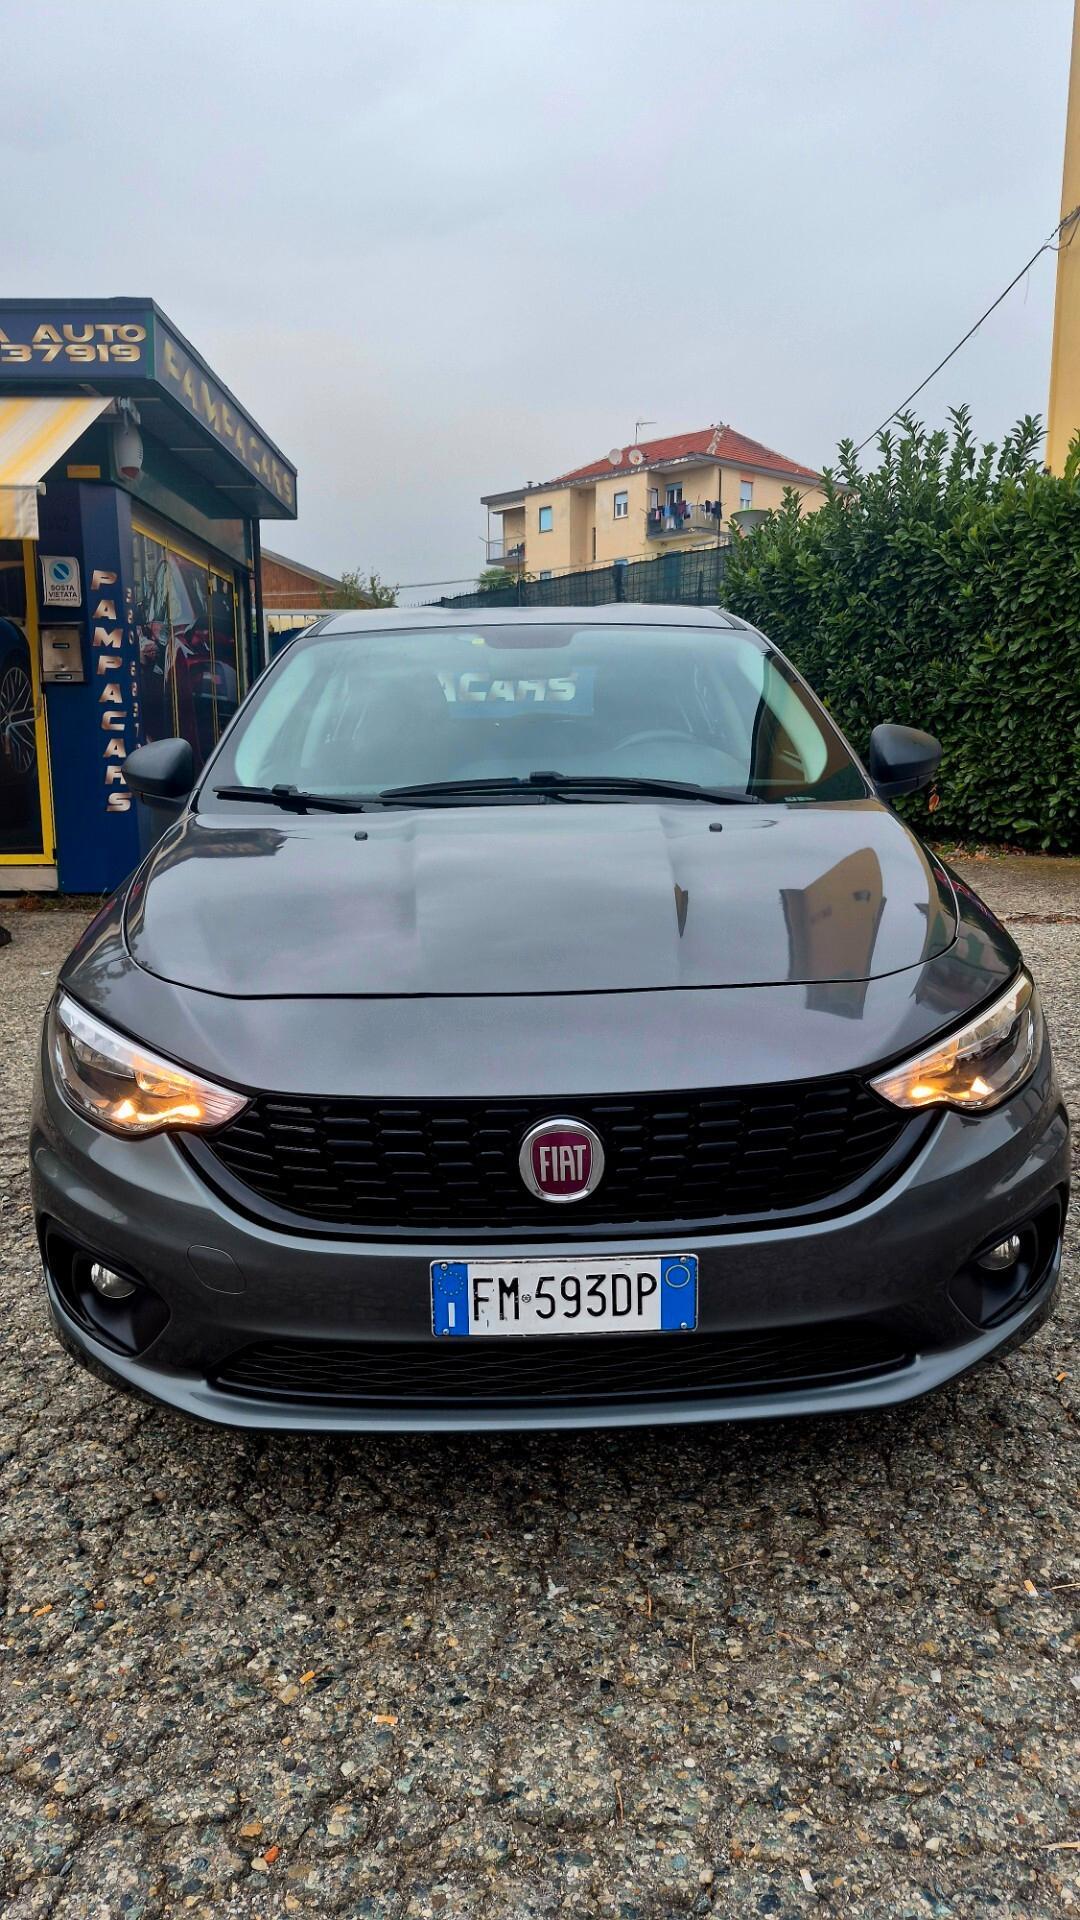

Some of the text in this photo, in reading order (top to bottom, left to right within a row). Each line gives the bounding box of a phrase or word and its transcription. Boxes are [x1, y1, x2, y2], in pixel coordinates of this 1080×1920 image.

[32, 324, 147, 342] AUTO
[0, 344, 141, 362] 37919
[90, 569, 132, 813] PAMPACARS
[539, 1144, 587, 1182] FIAT
